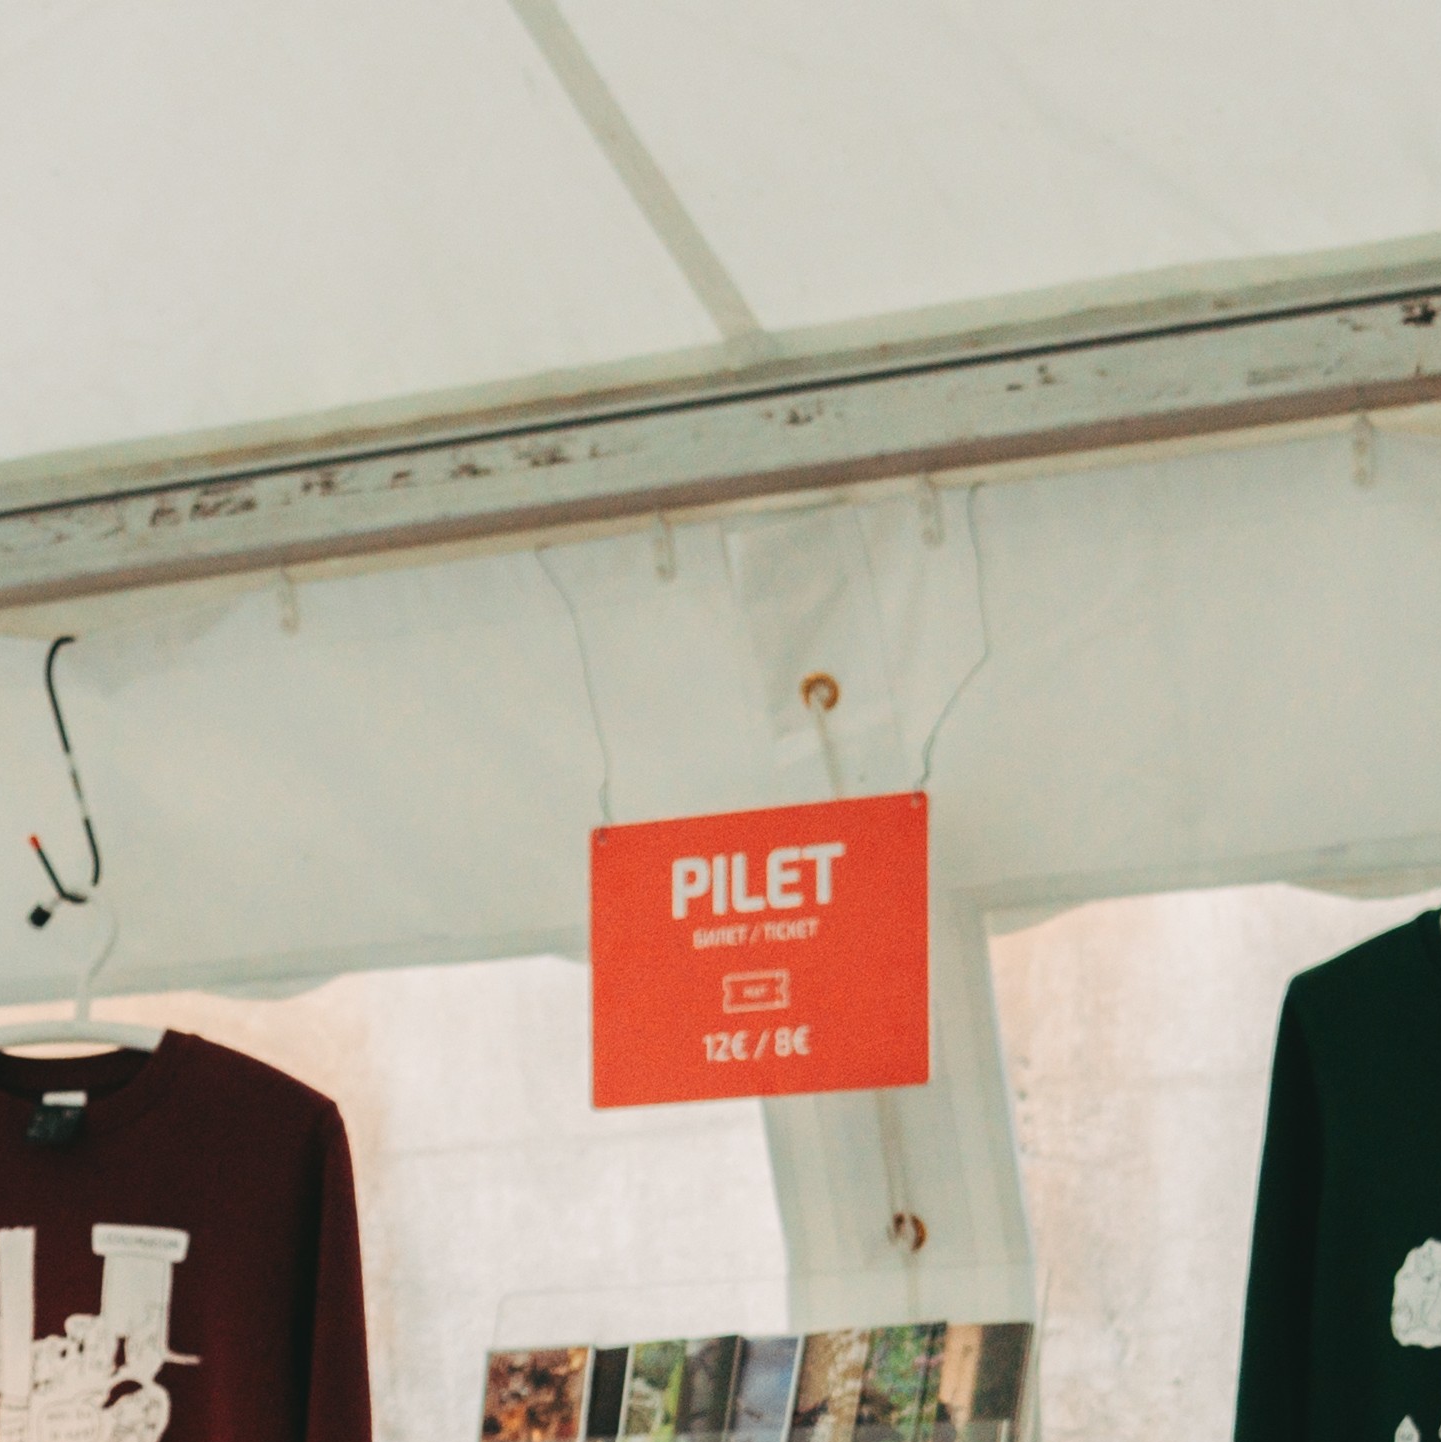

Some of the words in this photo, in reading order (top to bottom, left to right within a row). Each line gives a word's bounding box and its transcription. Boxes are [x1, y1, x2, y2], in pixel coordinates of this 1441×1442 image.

[672, 843, 845, 919] PILET
[764, 918, 819, 941] TICKET
[703, 1030, 748, 1062] 12€
[752, 1029, 770, 1060] /
[774, 1024, 812, 1057] 8€
